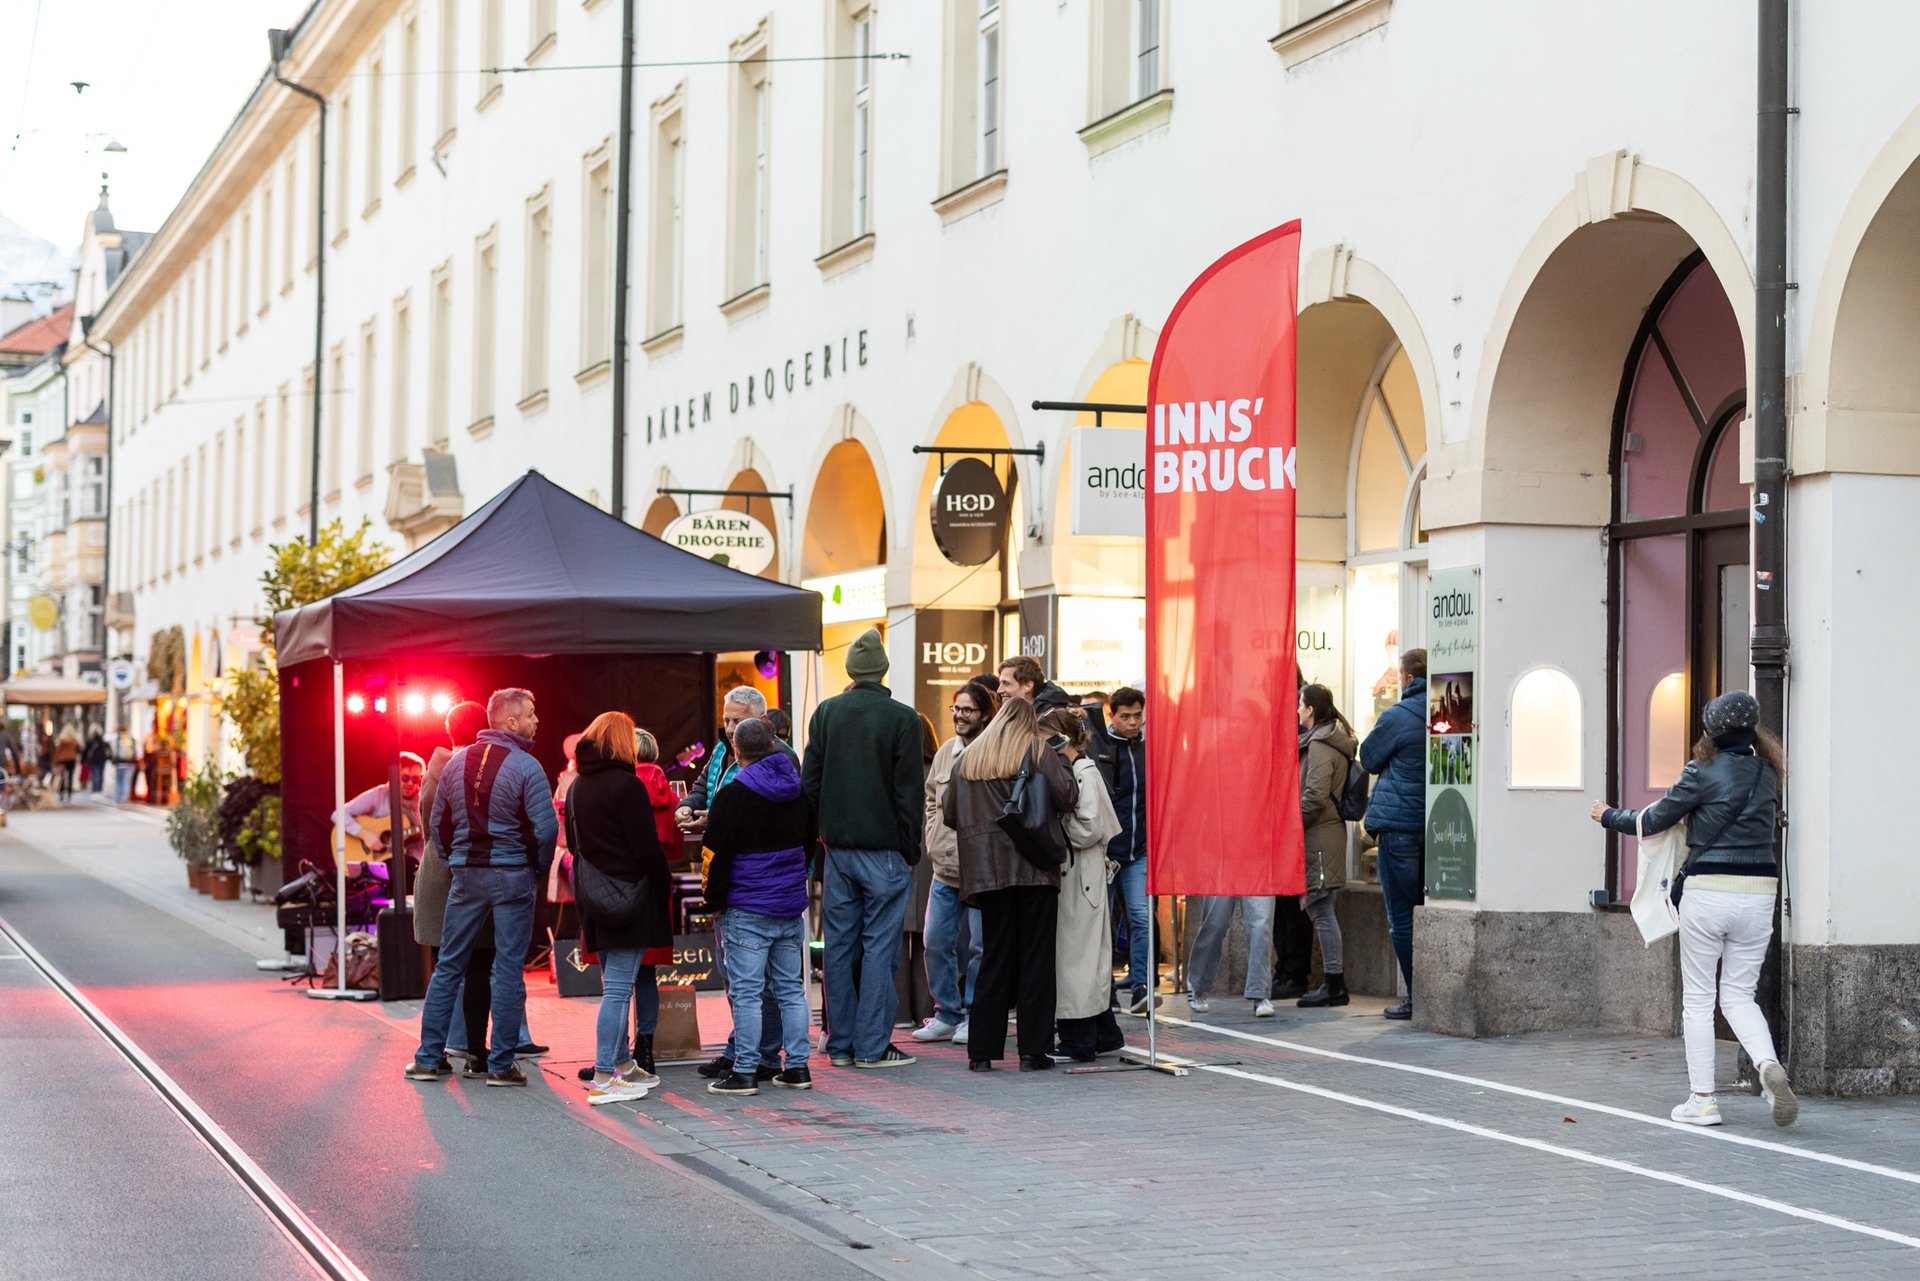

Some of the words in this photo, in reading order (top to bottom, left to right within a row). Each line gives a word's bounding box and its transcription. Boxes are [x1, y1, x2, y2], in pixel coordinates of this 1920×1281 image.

[646, 391, 712, 444] BÄREN
[729, 330, 868, 414] DROGERIE
[1154, 446, 1297, 494] BRUCK
[946, 494, 996, 511] HOD
[1099, 490, 1109, 499] by
[692, 515, 751, 531] BÄREN
[677, 534, 765, 548] DROGERIE
[1433, 587, 1474, 619] andou.
[922, 642, 986, 665] HOD
[1022, 635, 1046, 657] HOD
